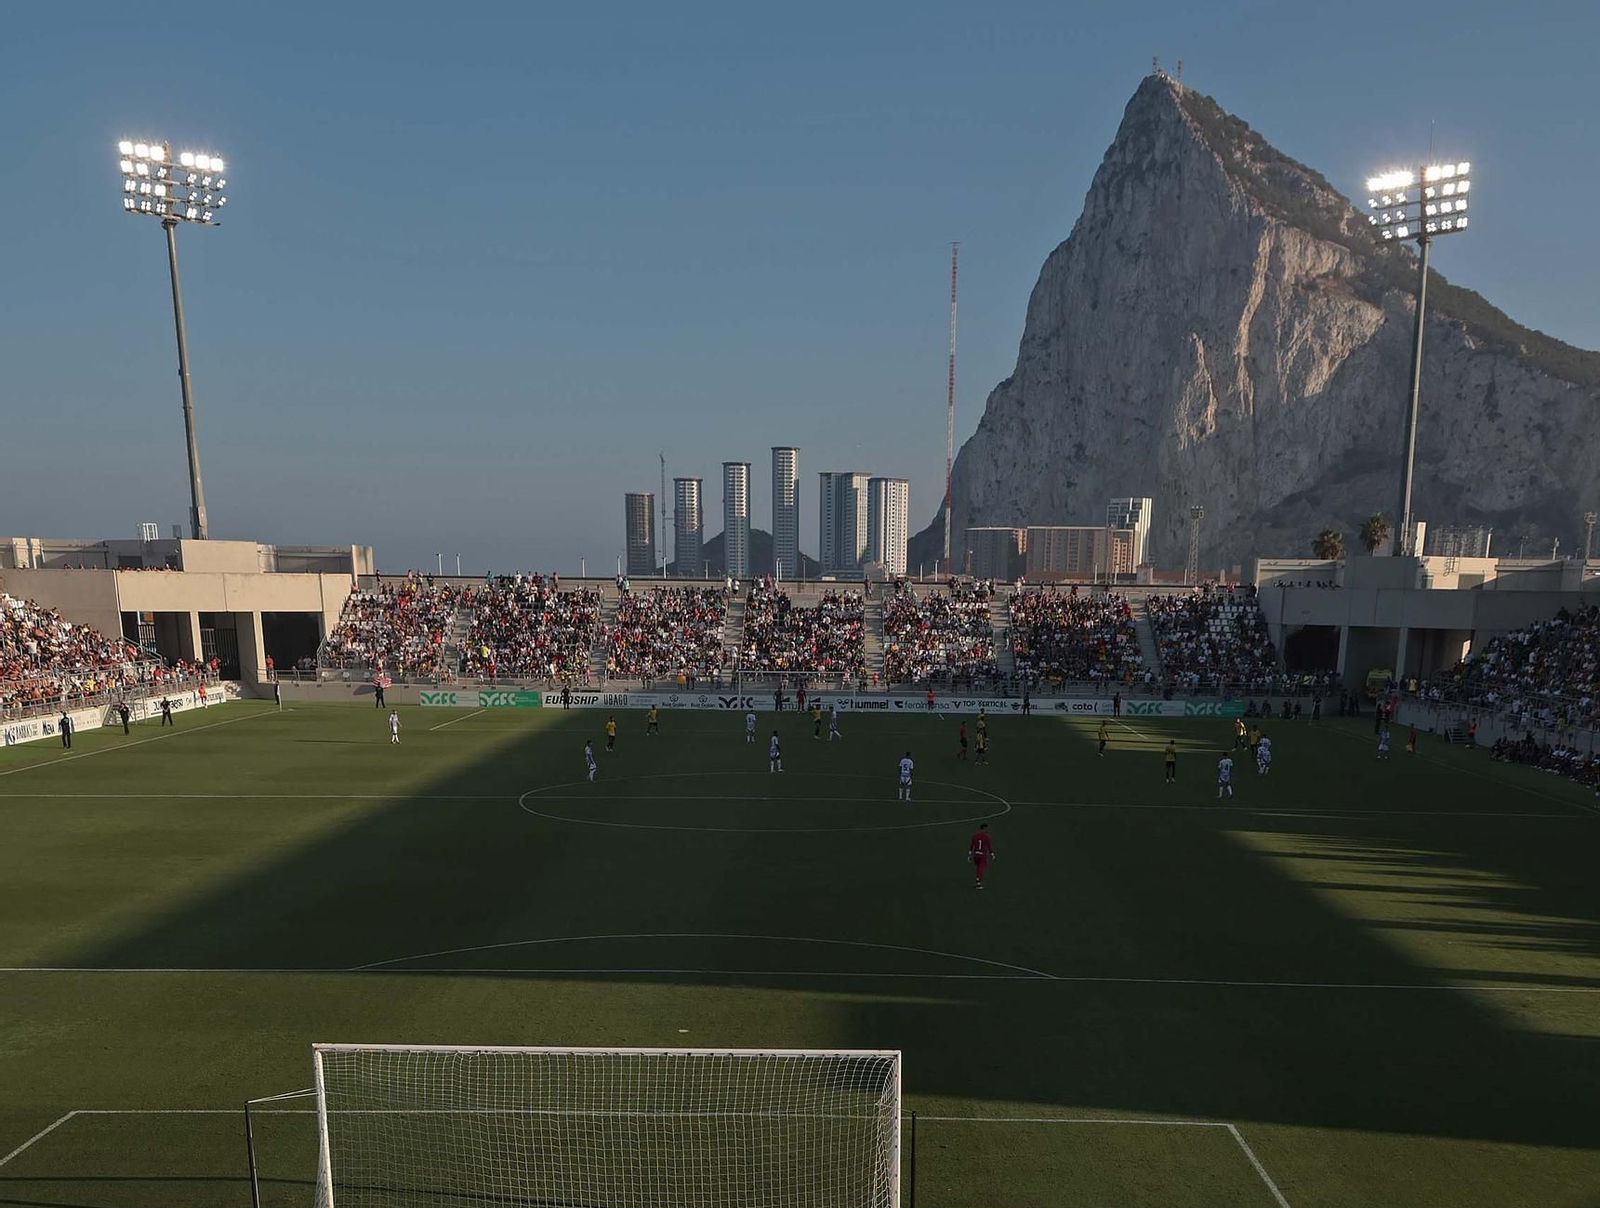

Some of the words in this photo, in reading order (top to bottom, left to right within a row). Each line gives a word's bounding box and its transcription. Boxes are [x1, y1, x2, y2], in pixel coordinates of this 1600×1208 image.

[603, 694, 628, 706] UBAGO
[851, 699, 889, 709] hummel
[963, 700, 976, 708] TOP
[1072, 702, 1093, 711] coto
